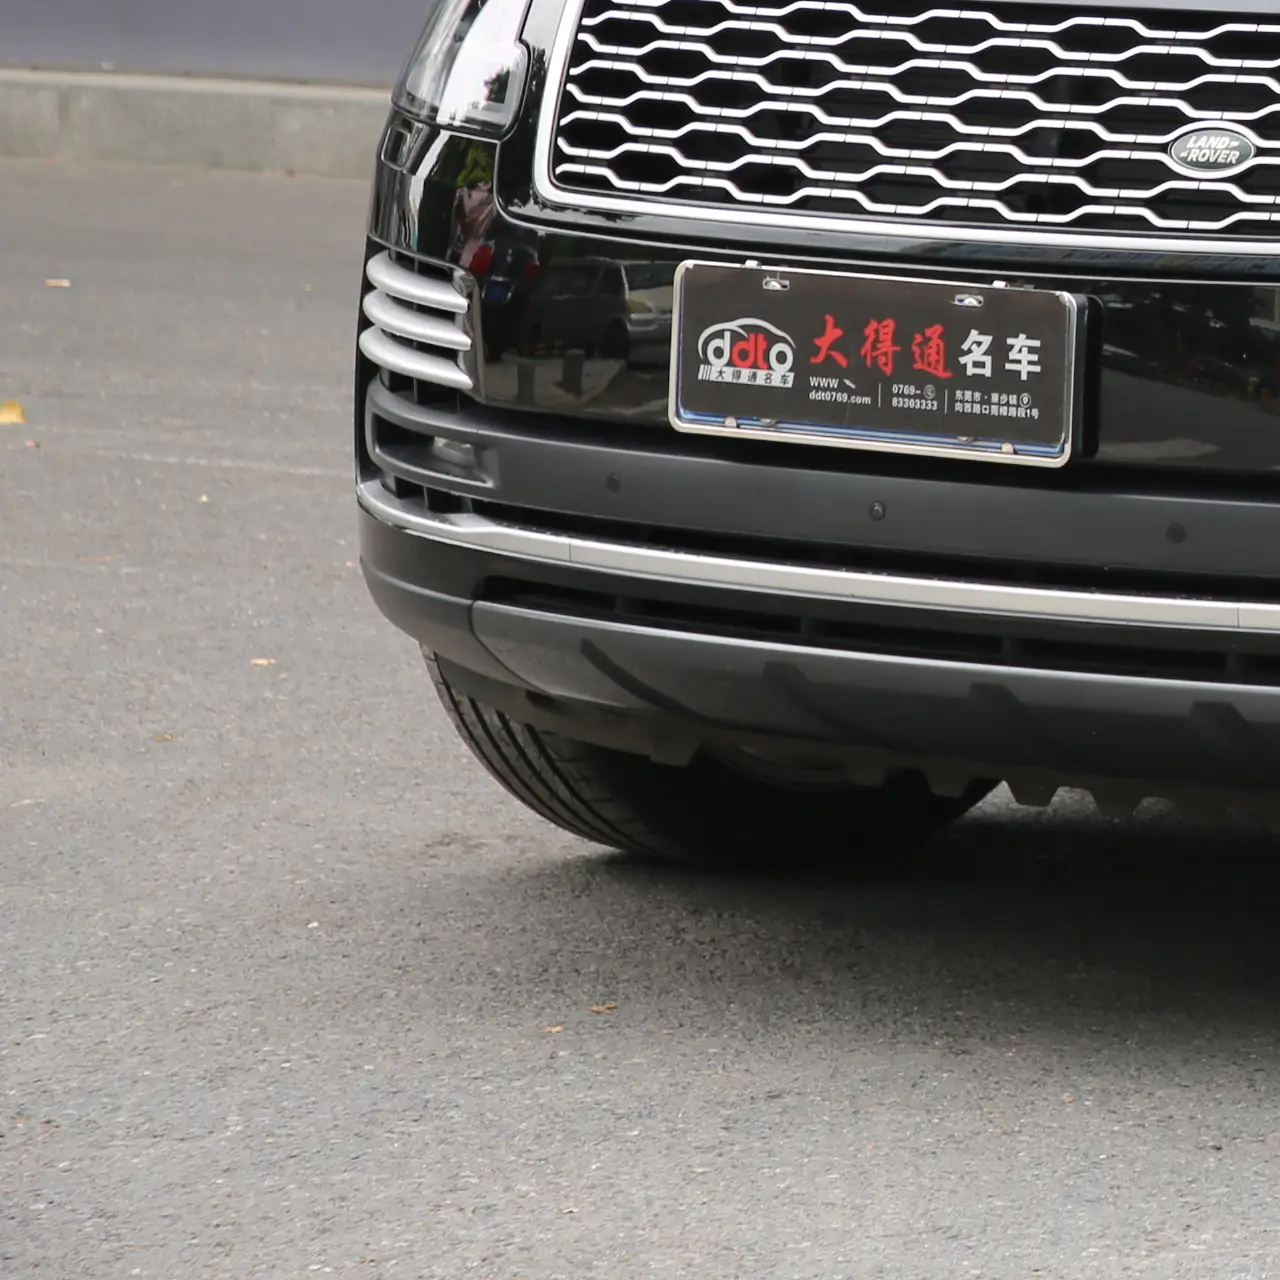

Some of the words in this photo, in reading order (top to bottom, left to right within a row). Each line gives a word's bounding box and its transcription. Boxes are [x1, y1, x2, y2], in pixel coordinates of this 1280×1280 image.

[1186, 135, 1230, 149] LAND
[1186, 148, 1240, 164] ROVER
[809, 314, 1041, 381] 大得通名车
[809, 390, 871, 405] ddt0769.com
